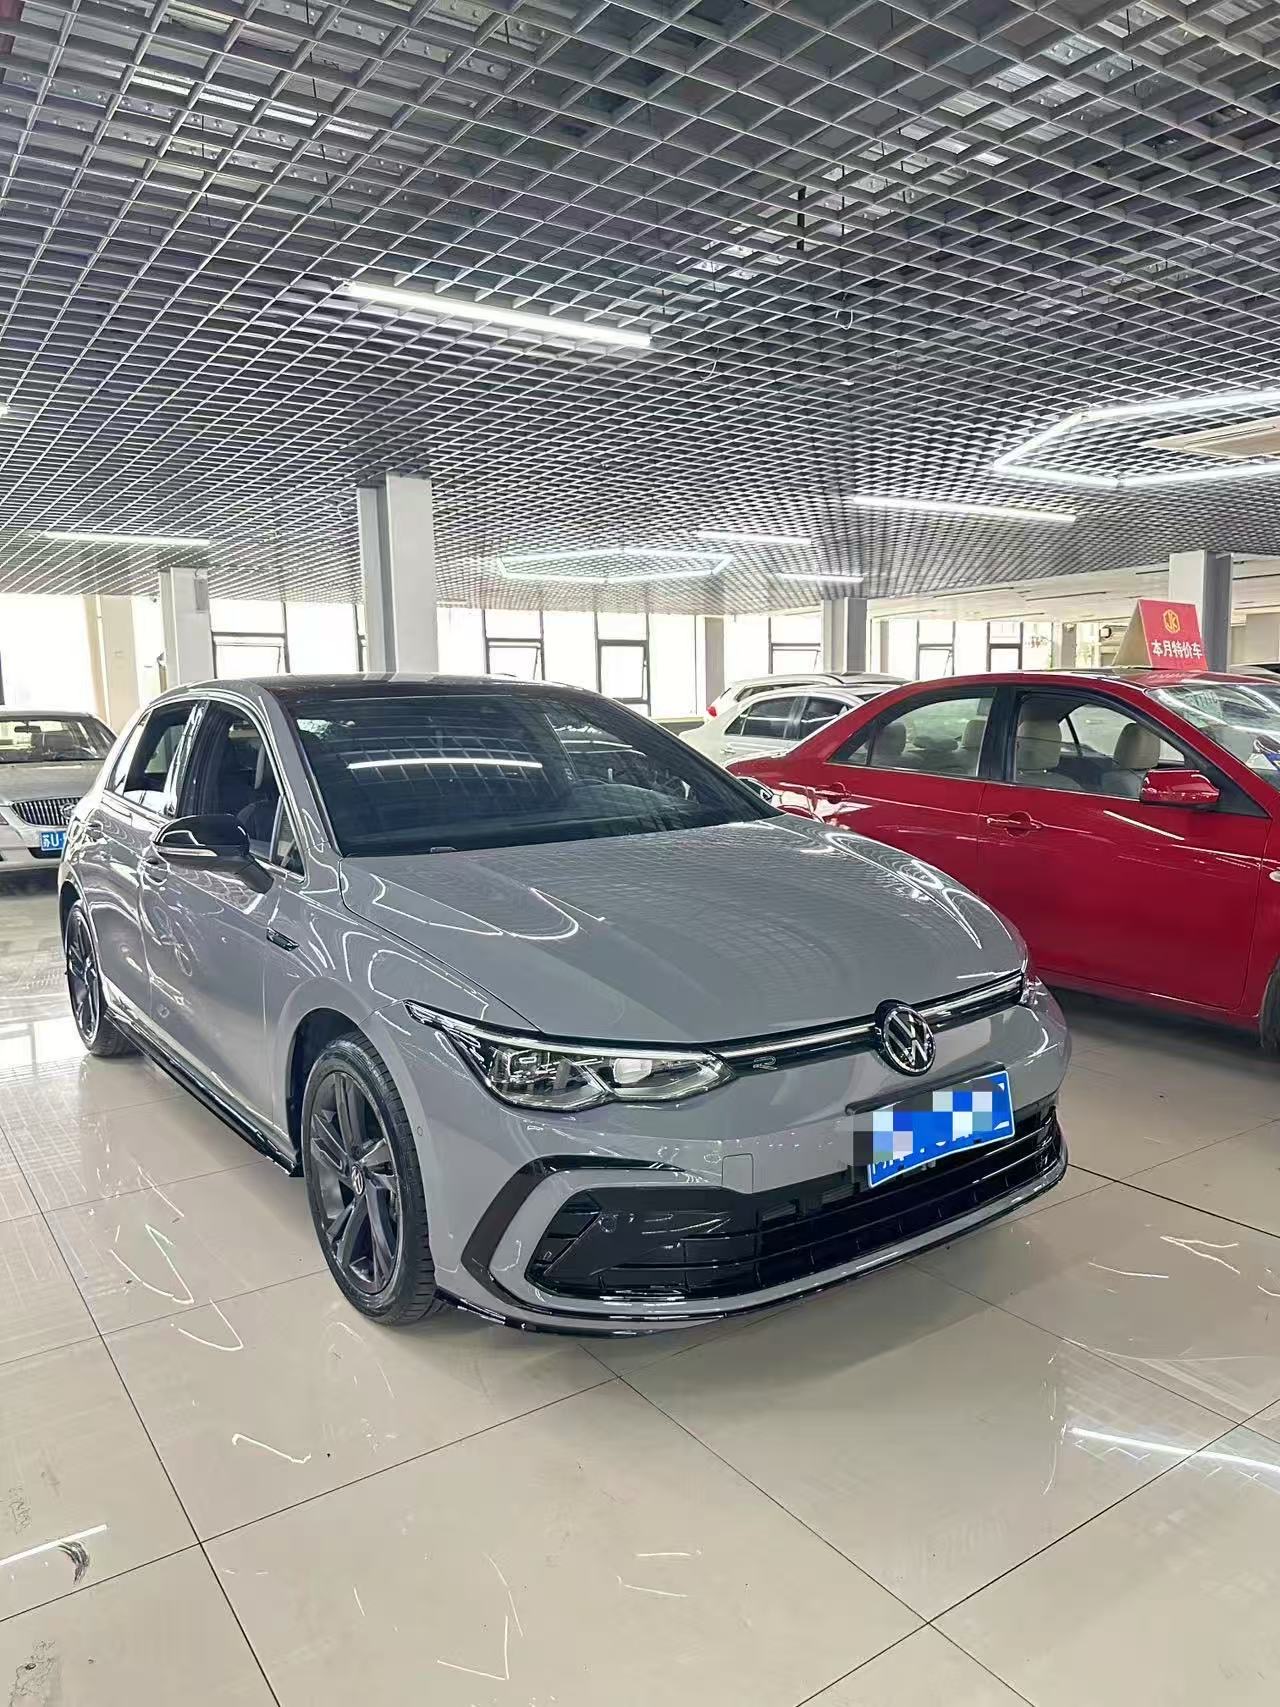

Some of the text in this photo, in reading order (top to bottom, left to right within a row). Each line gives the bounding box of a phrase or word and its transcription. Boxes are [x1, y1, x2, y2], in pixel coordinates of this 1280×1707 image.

[1151, 639, 1203, 659] 本月特价车
